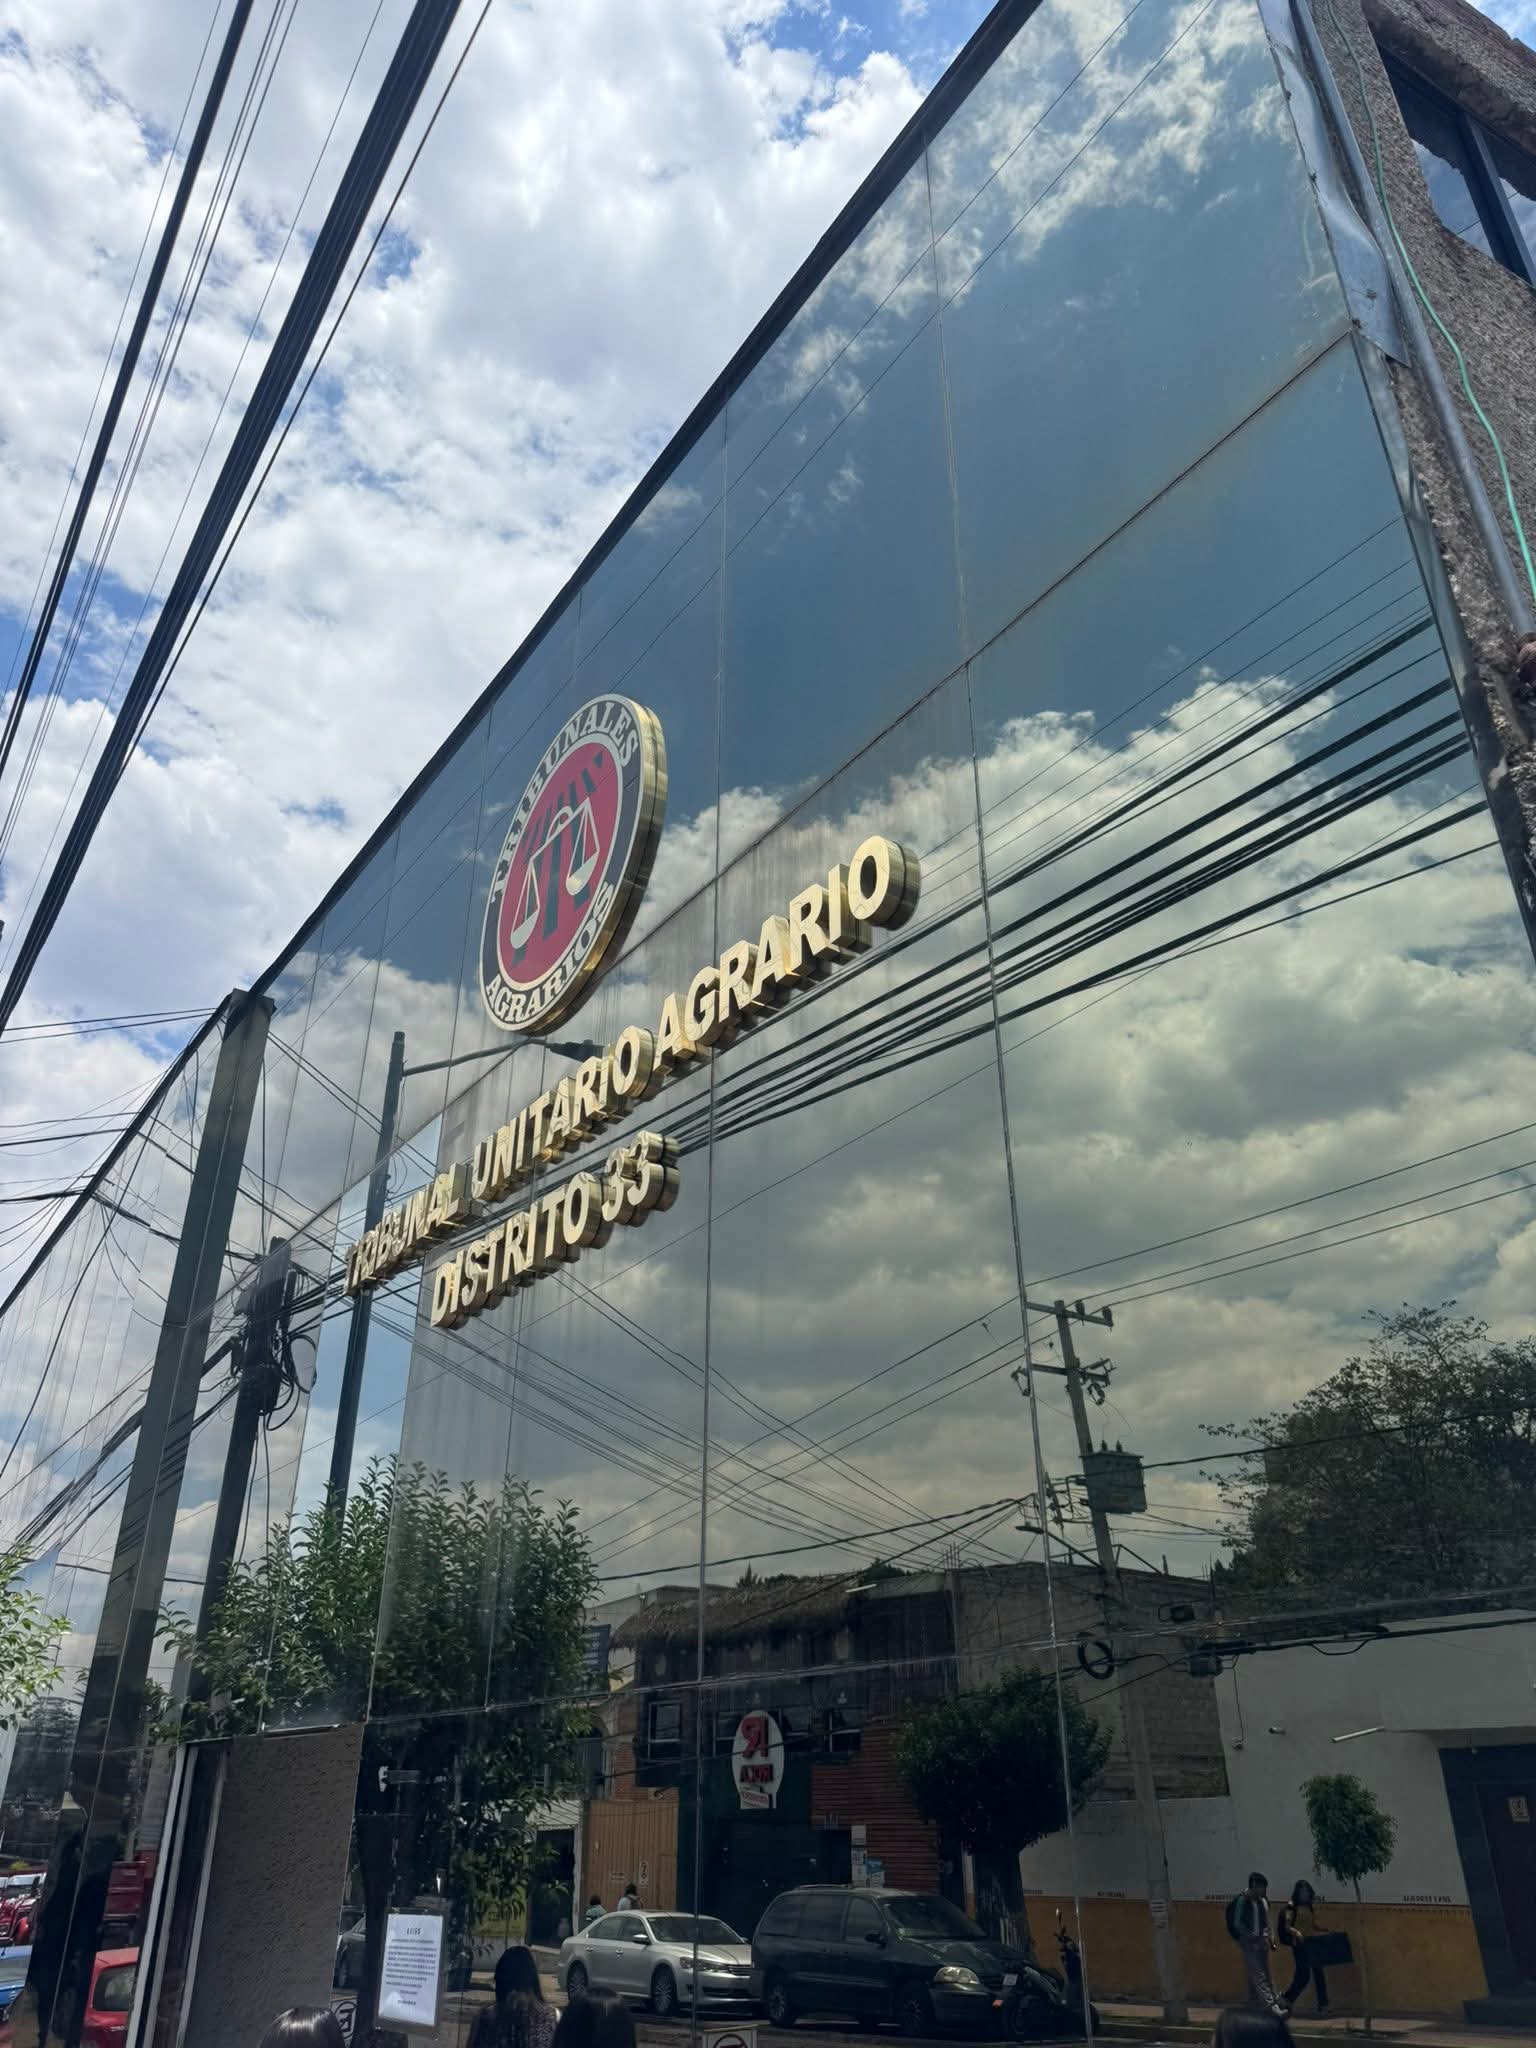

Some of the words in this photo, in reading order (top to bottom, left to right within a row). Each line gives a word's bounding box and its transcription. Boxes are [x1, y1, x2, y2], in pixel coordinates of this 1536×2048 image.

[489, 700, 641, 904] TRIBUNALES
[486, 881, 616, 1023] AGRARIOS
[345, 1165, 463, 1297] TRIBUNAL
[472, 1026, 644, 1203] UNITARIO
[652, 835, 898, 1074] AGRARIO
[431, 1171, 595, 1328] DISTRITO
[602, 1131, 668, 1224] 33
